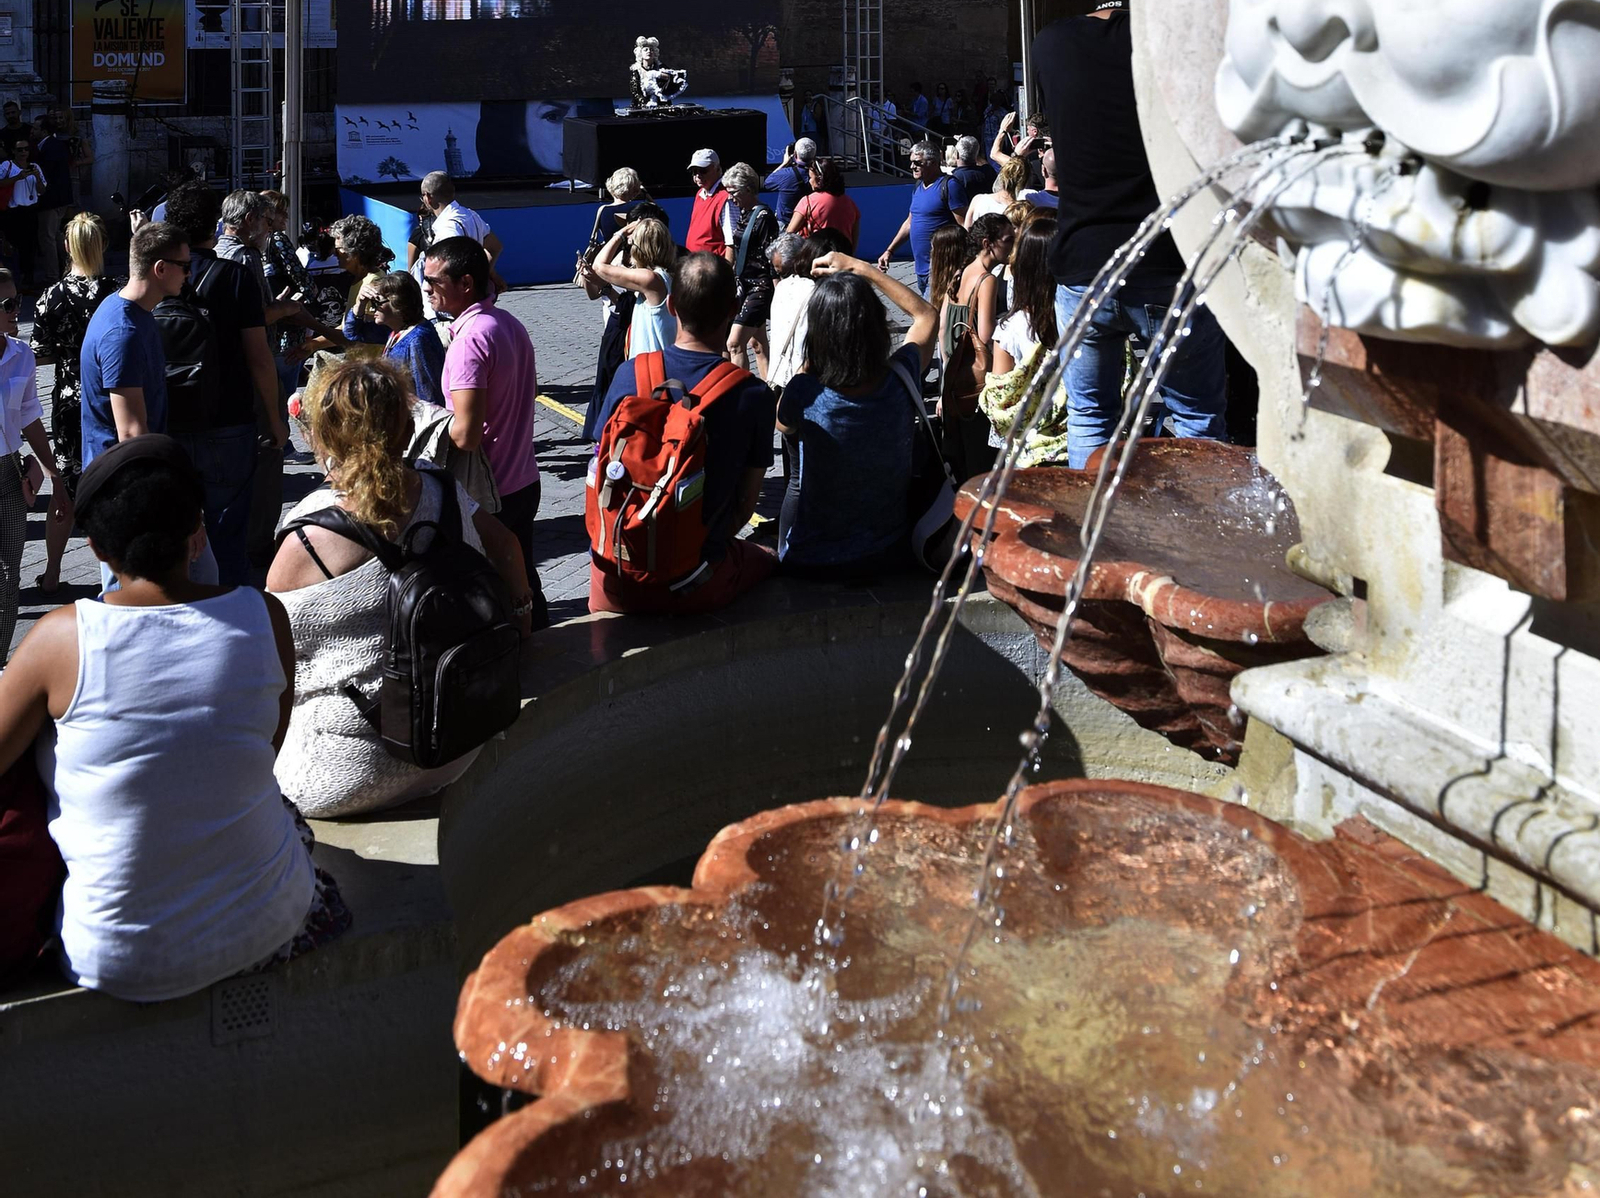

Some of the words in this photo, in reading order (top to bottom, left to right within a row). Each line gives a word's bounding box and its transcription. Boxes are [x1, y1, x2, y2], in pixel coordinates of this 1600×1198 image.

[1095, 0, 1123, 11] SONY
[93, 18, 165, 40] VALIENTE
[93, 52, 166, 67] DOMUND
